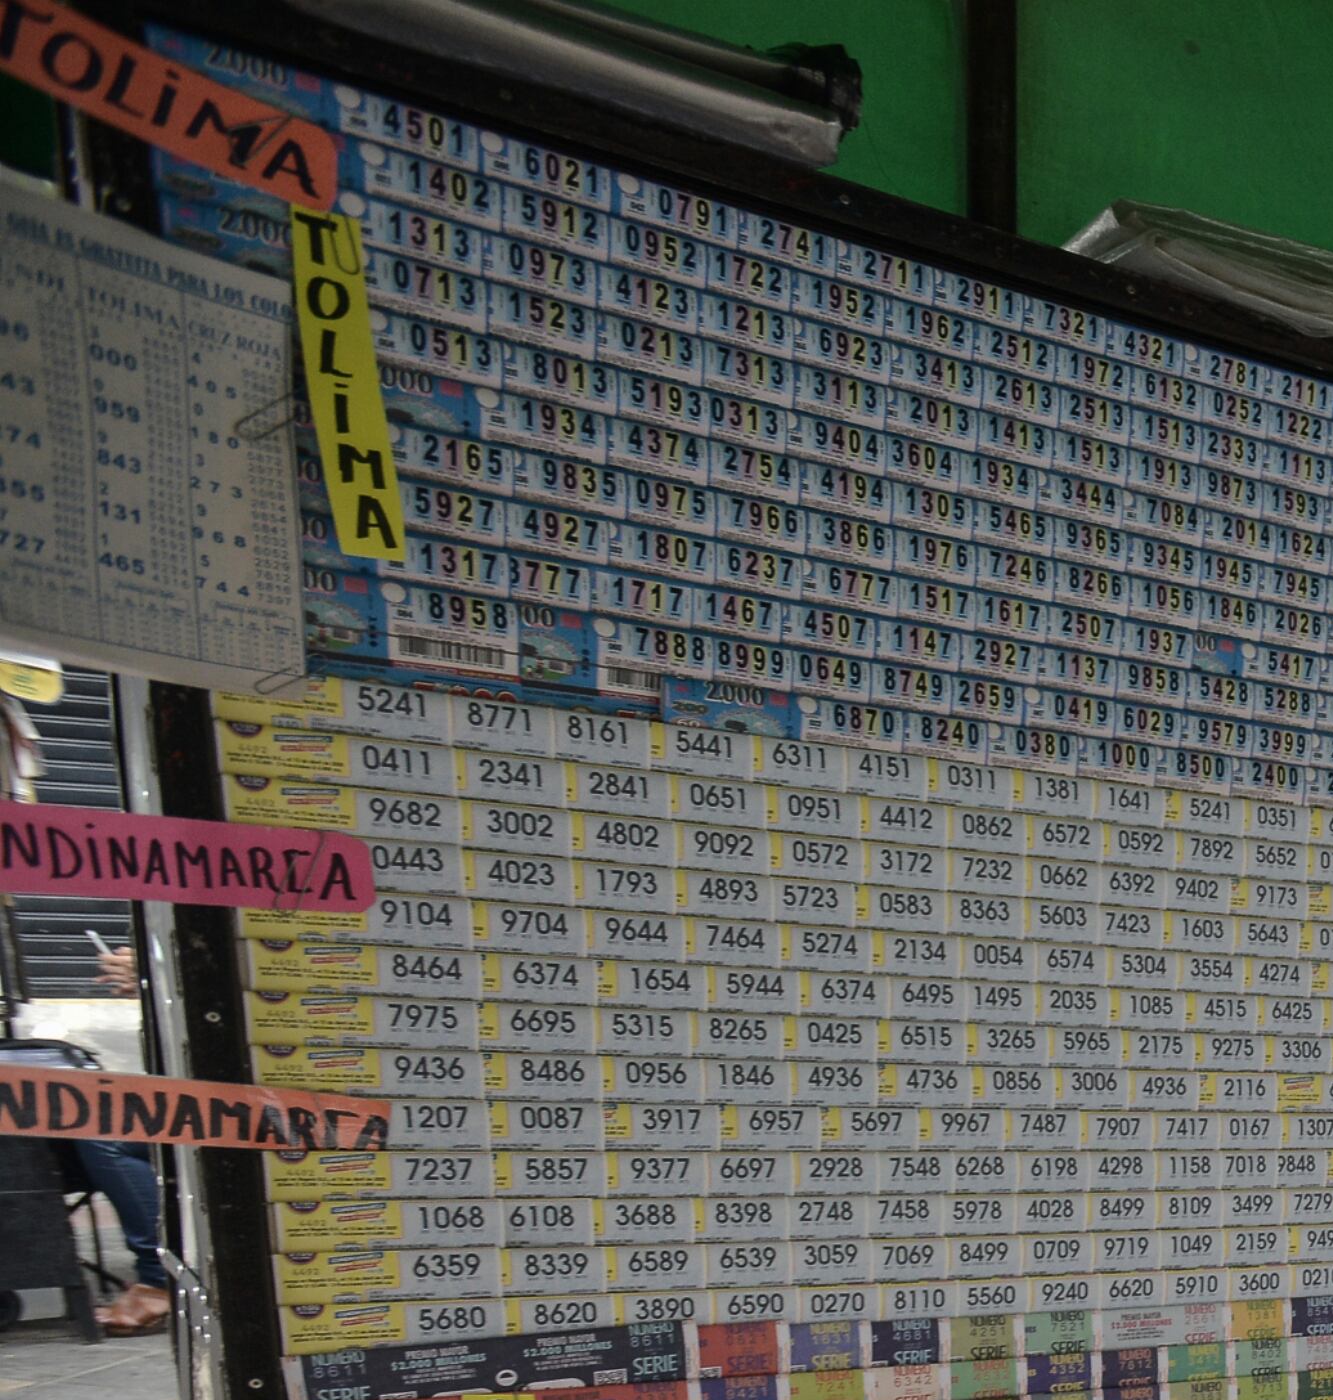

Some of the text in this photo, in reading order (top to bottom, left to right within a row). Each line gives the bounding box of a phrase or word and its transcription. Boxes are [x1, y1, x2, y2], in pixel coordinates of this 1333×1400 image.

[384, 105, 464, 152] 4501
[409, 161, 490, 208] 1402
[525, 148, 599, 193] 6021
[522, 196, 598, 238] 5912
[659, 189, 728, 233] 0791
[389, 211, 470, 257] 1313
[761, 220, 826, 261] 2741
[394, 260, 475, 305] 0713
[865, 252, 924, 290] 2711
[616, 274, 688, 316] 4123
[411, 324, 491, 366] 0513
[819, 329, 884, 366] 6923
[533, 354, 607, 394] 8013
[522, 402, 596, 438] 1934
[423, 435, 503, 476] 2165
[415, 487, 495, 526] 5927
[732, 500, 799, 534] 7966
[421, 543, 498, 580] 1317
[429, 593, 509, 630] 8958
[635, 629, 705, 661] 7888
[1268, 652, 1315, 680] 5417
[357, 685, 426, 718] 5241
[921, 717, 980, 746] 8240
[361, 744, 430, 775] 0411
[369, 797, 441, 827] 9682
[487, 809, 554, 838] 3002
[371, 844, 444, 872] 0443
[596, 868, 658, 895] 1793
[1175, 876, 1219, 900] 9402
[782, 884, 839, 909] 5723
[380, 899, 453, 927] 9104
[392, 953, 463, 981] 8464
[1049, 989, 1097, 1011] 2035
[387, 1003, 458, 1030] 7975
[709, 1017, 768, 1041] 8265
[807, 1021, 863, 1045] 0425
[394, 1055, 465, 1080] 9436
[1223, 1078, 1266, 1097] 2116
[402, 1105, 468, 1129] 1207
[1096, 1117, 1141, 1137] 7907
[405, 1157, 473, 1181] 7237
[630, 1157, 690, 1180] 9377
[418, 1205, 485, 1230] 1068
[877, 1198, 930, 1220] 7458
[1033, 1239, 1081, 1260] 0709
[412, 1252, 481, 1278] 6359
[418, 1305, 486, 1331] 5680
[633, 1355, 678, 1376] SERIE
